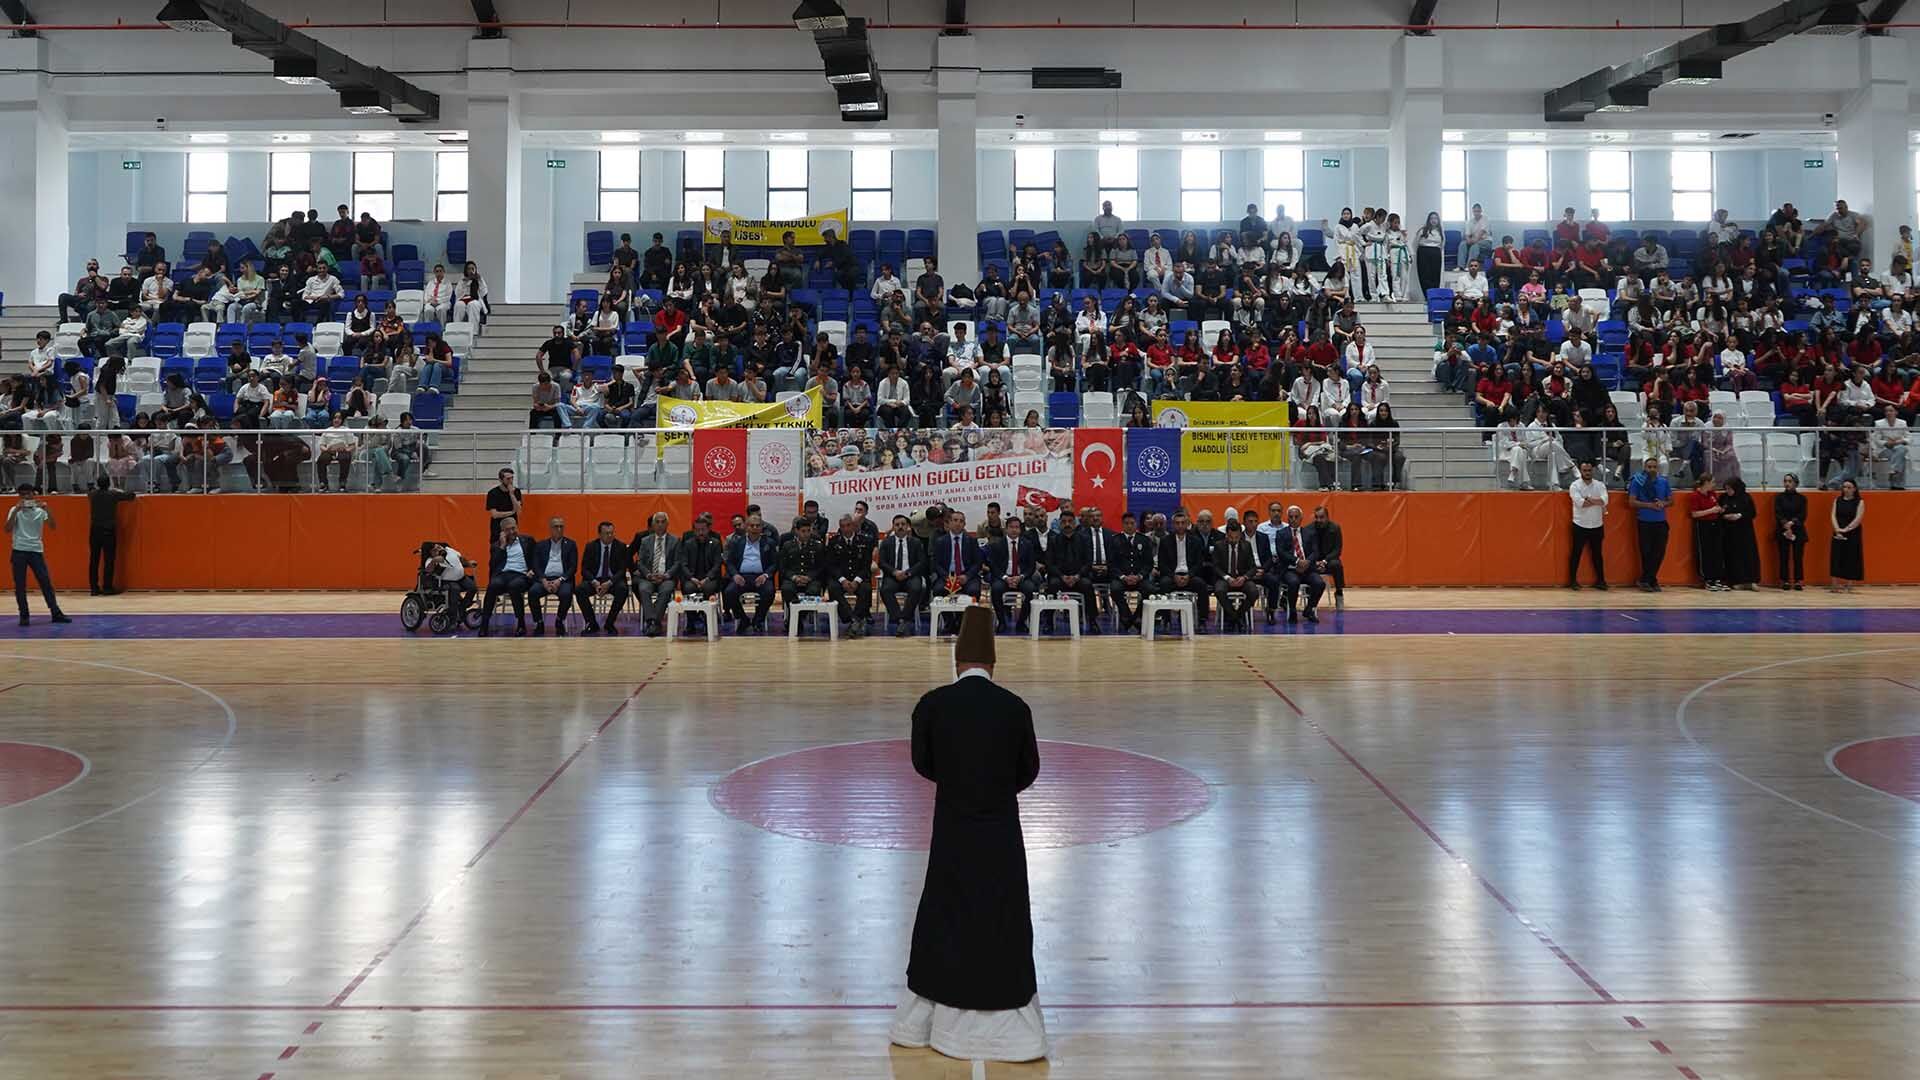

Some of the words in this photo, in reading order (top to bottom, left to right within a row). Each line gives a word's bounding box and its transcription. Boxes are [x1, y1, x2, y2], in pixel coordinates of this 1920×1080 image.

[1249, 432, 1258, 440] VE
[1192, 445, 1225, 453] ANADOLU
[829, 471, 922, 496] TÜRKİYE'NİN
